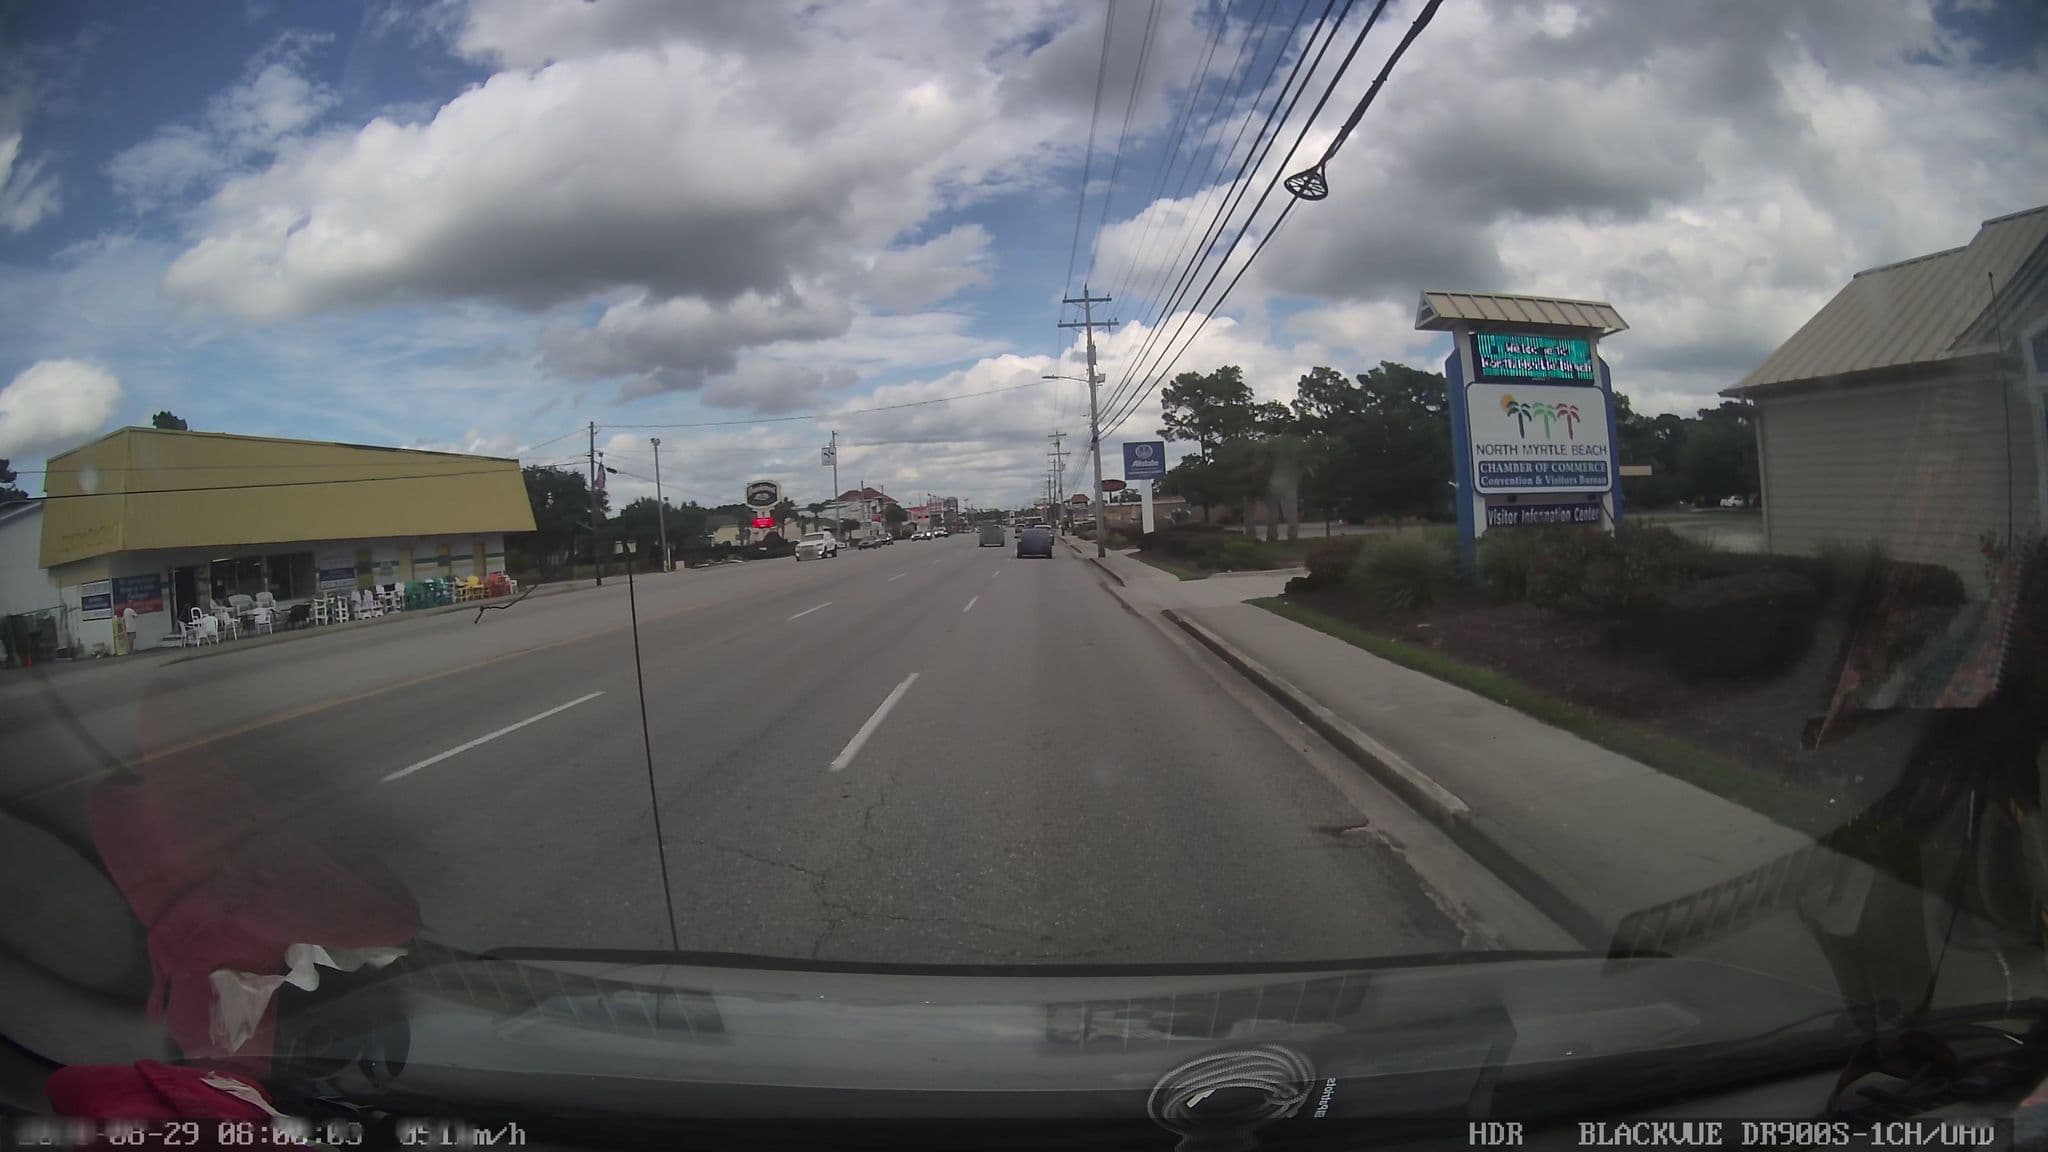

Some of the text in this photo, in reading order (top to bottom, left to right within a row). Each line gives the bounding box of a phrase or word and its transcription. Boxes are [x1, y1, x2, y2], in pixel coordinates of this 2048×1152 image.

[1476, 444, 1607, 456] NORTH MYRTLE BEACH
[1480, 462, 1607, 473] CHAMBER OF COMMERCE
[1481, 475, 1607, 486] Convention & Visitors Bureau
[1488, 509, 1518, 526] Visitor
[1574, 507, 1599, 521] Center
